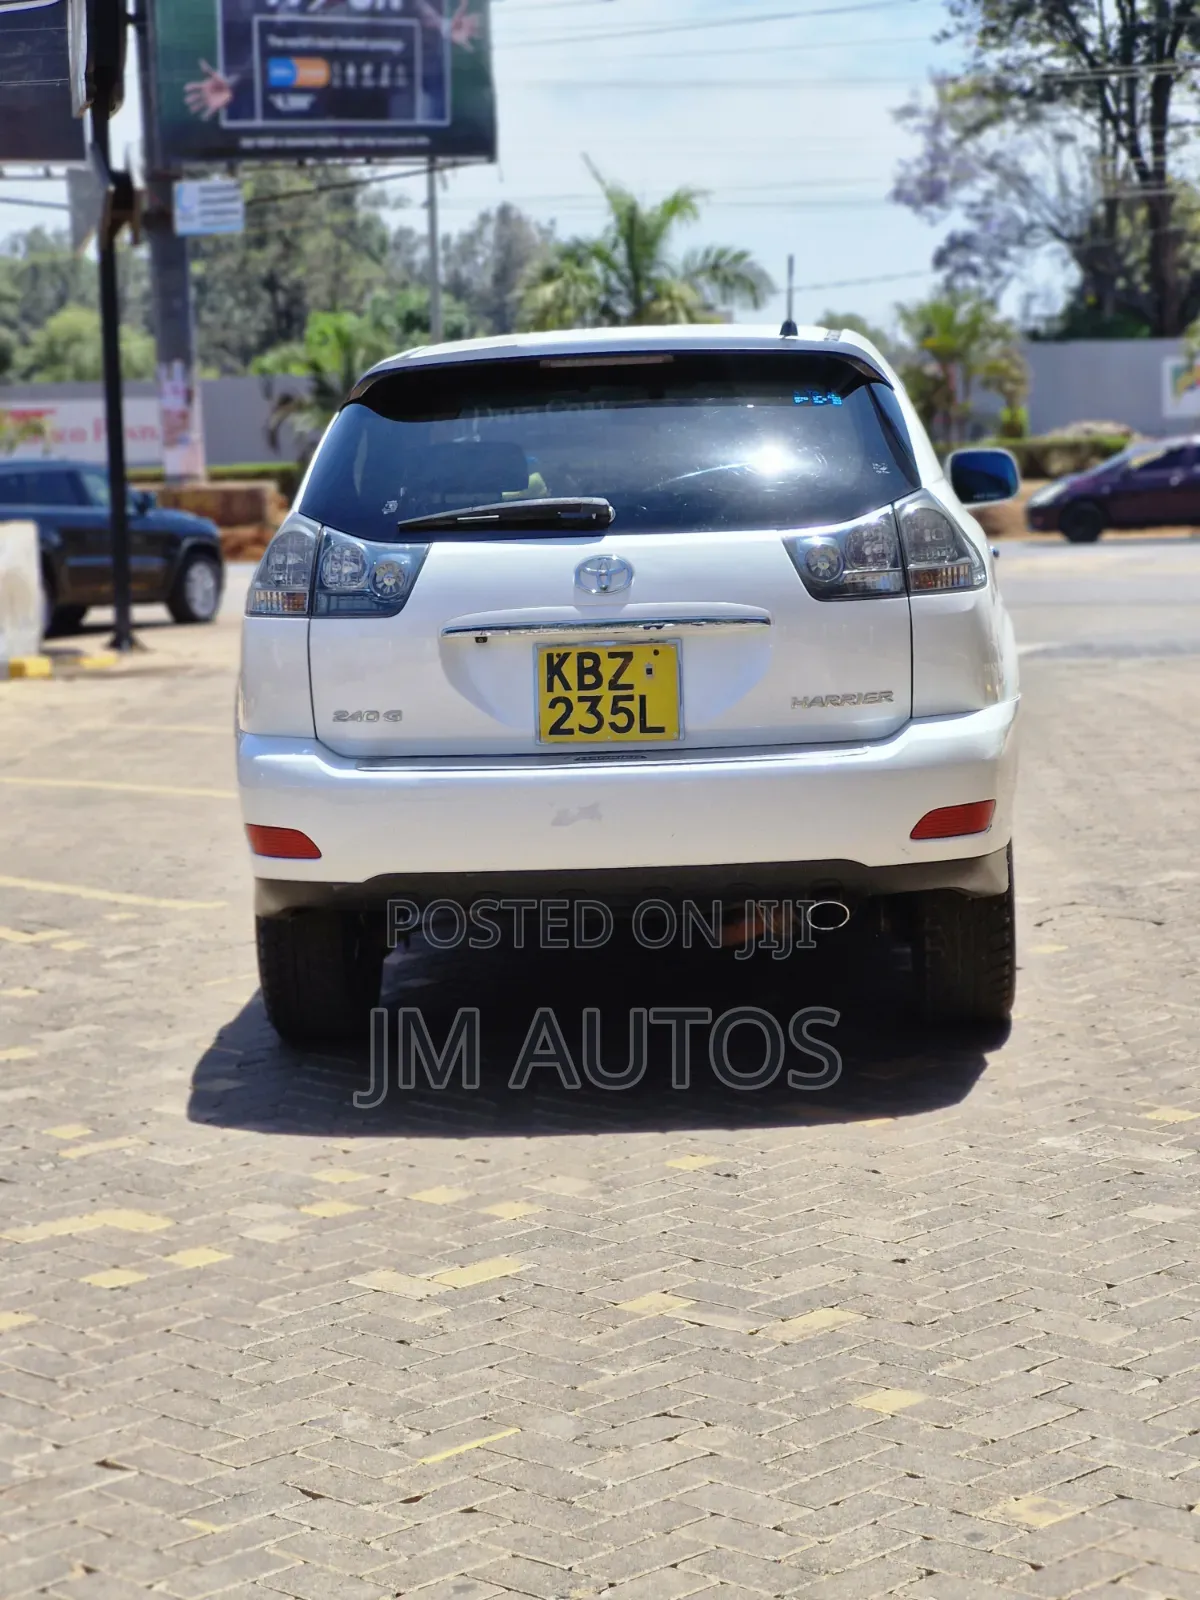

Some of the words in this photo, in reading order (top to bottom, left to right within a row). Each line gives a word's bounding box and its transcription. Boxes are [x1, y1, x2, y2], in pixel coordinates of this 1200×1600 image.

[546, 652, 634, 693] KBZ
[548, 694, 666, 736] 235L
[790, 690, 894, 710] HARRIER
